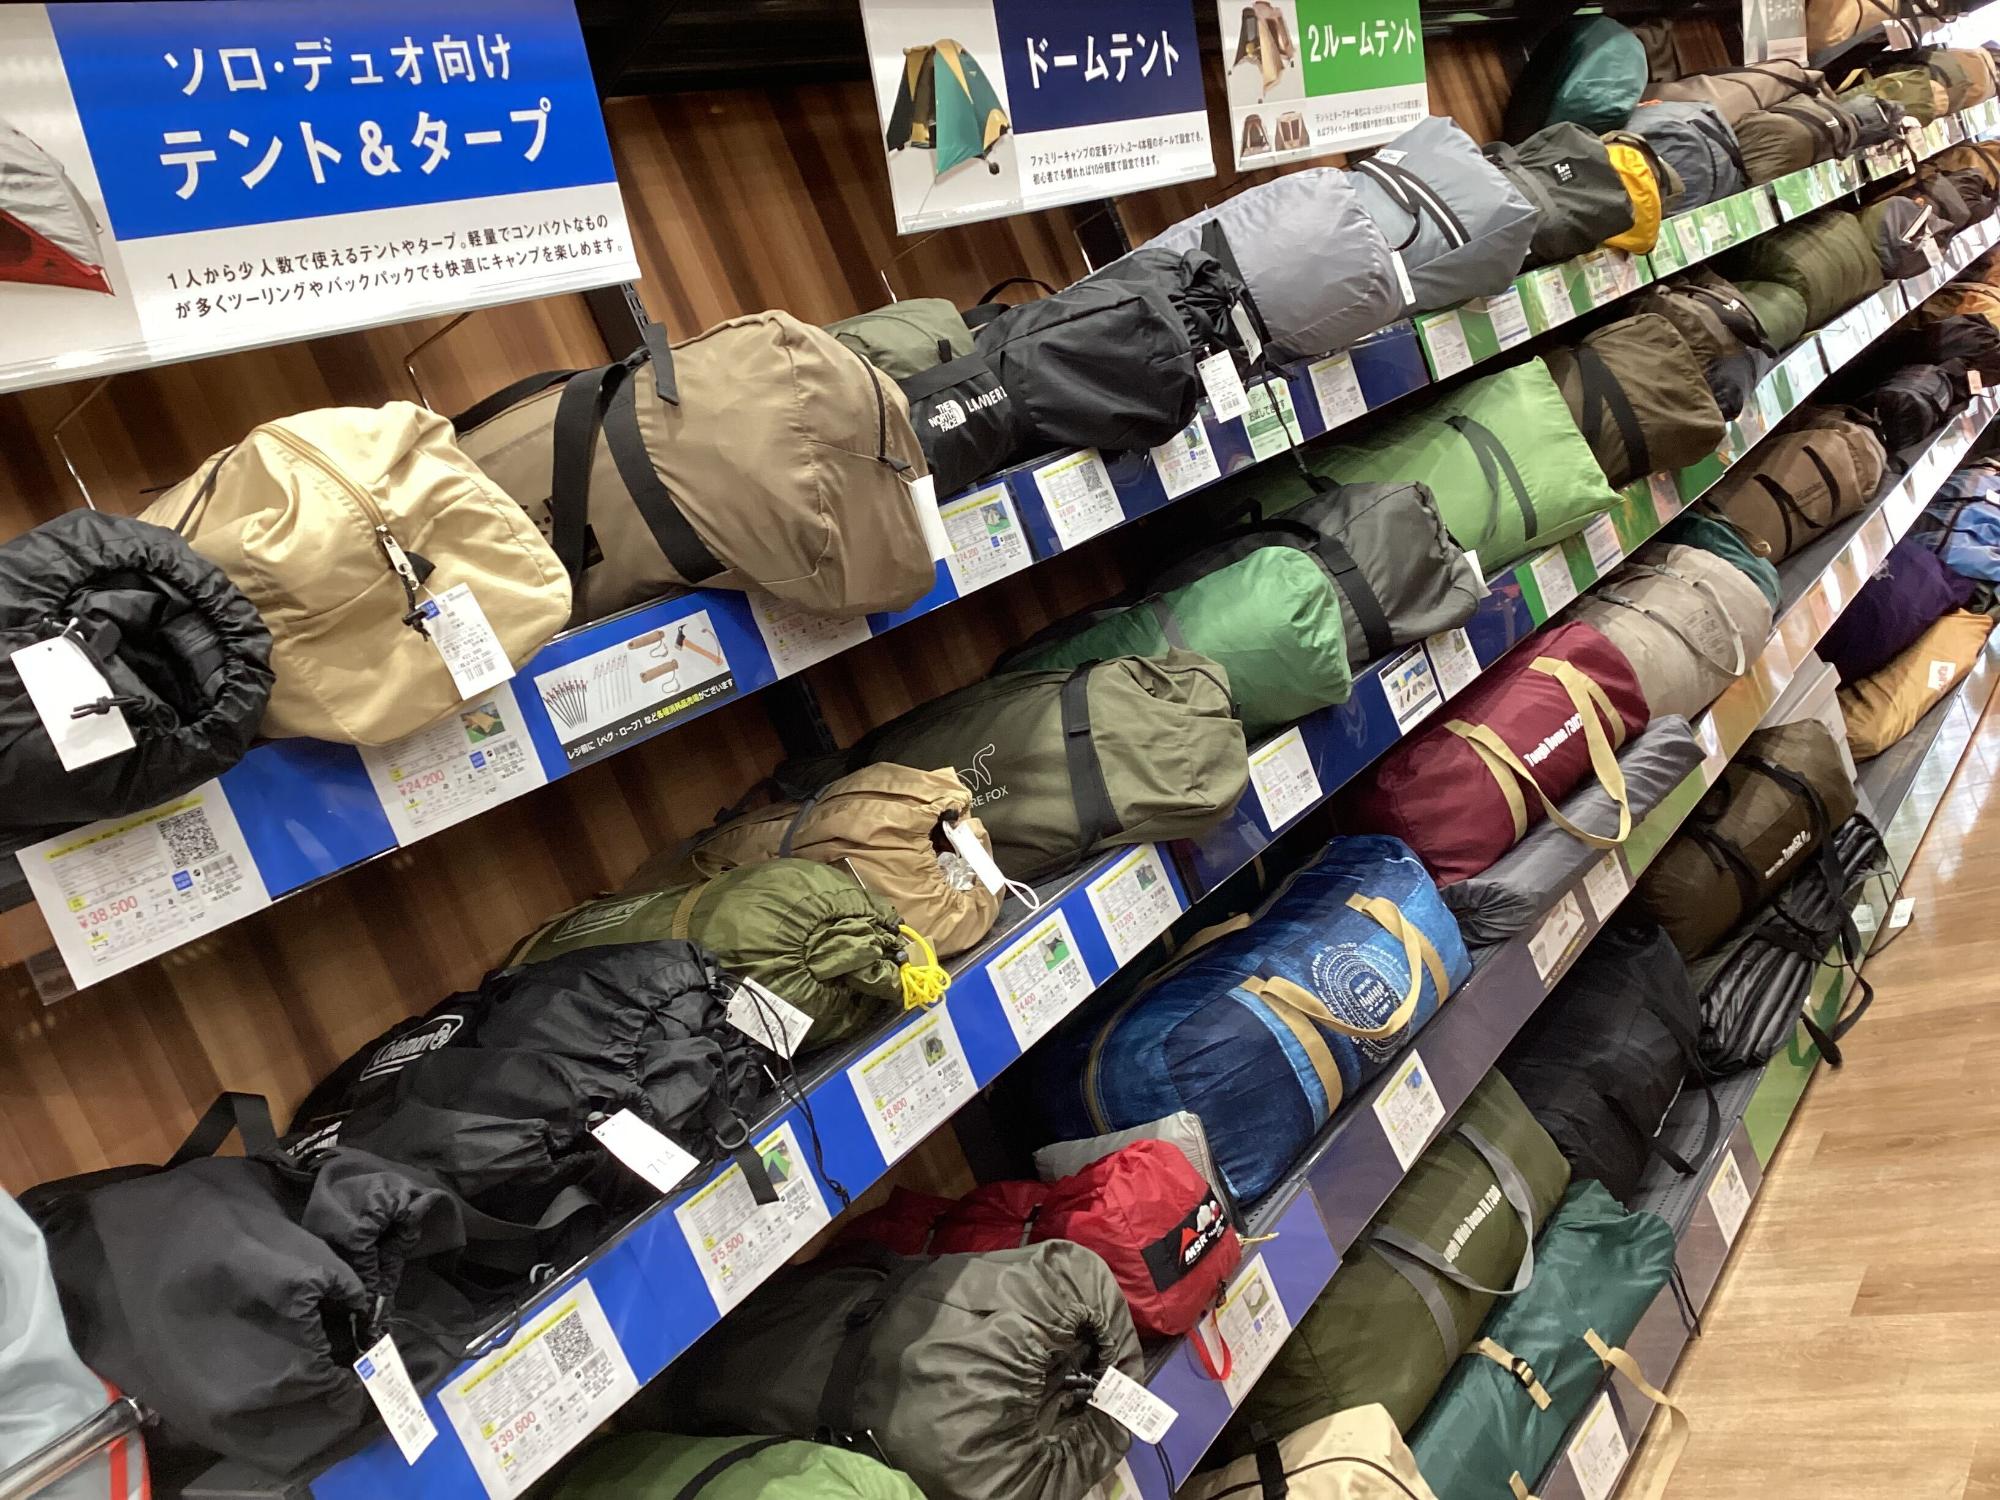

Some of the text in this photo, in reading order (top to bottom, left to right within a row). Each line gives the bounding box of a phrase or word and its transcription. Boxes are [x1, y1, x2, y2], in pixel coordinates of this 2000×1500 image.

[1307, 16, 1418, 64] 2ルームテント
[163, 33, 513, 97] ソロ・デュオ向け
[1026, 29, 1181, 90] ドームテント
[159, 97, 552, 200] テント&タープ
[167, 214, 610, 291] 1人から少人数で使えるテントやタープ。軽量でコンパクトなもの
[175, 242, 625, 321] が多くツーリングやバックパックでも快適にキャンプを楽しめます。
[927, 409, 955, 428] NORTH
[935, 400, 953, 415] THE
[940, 418, 958, 433] FACE
[1523, 742, 1551, 767] Tough
[1543, 728, 1569, 751] Dome
[399, 769, 446, 796] ¥24,200
[985, 785, 1009, 803] FOX
[79, 895, 140, 930] ¥38,500
[882, 1097, 908, 1122] ¥8,800
[1463, 1207, 1486, 1230] Dome
[711, 1233, 745, 1265] ¥5,500
[1184, 1232, 1209, 1263] MSR
[1452, 1223, 1473, 1247] Wide
[1443, 1239, 1462, 1264] ough
[492, 1411, 537, 1454] ¥39,600
